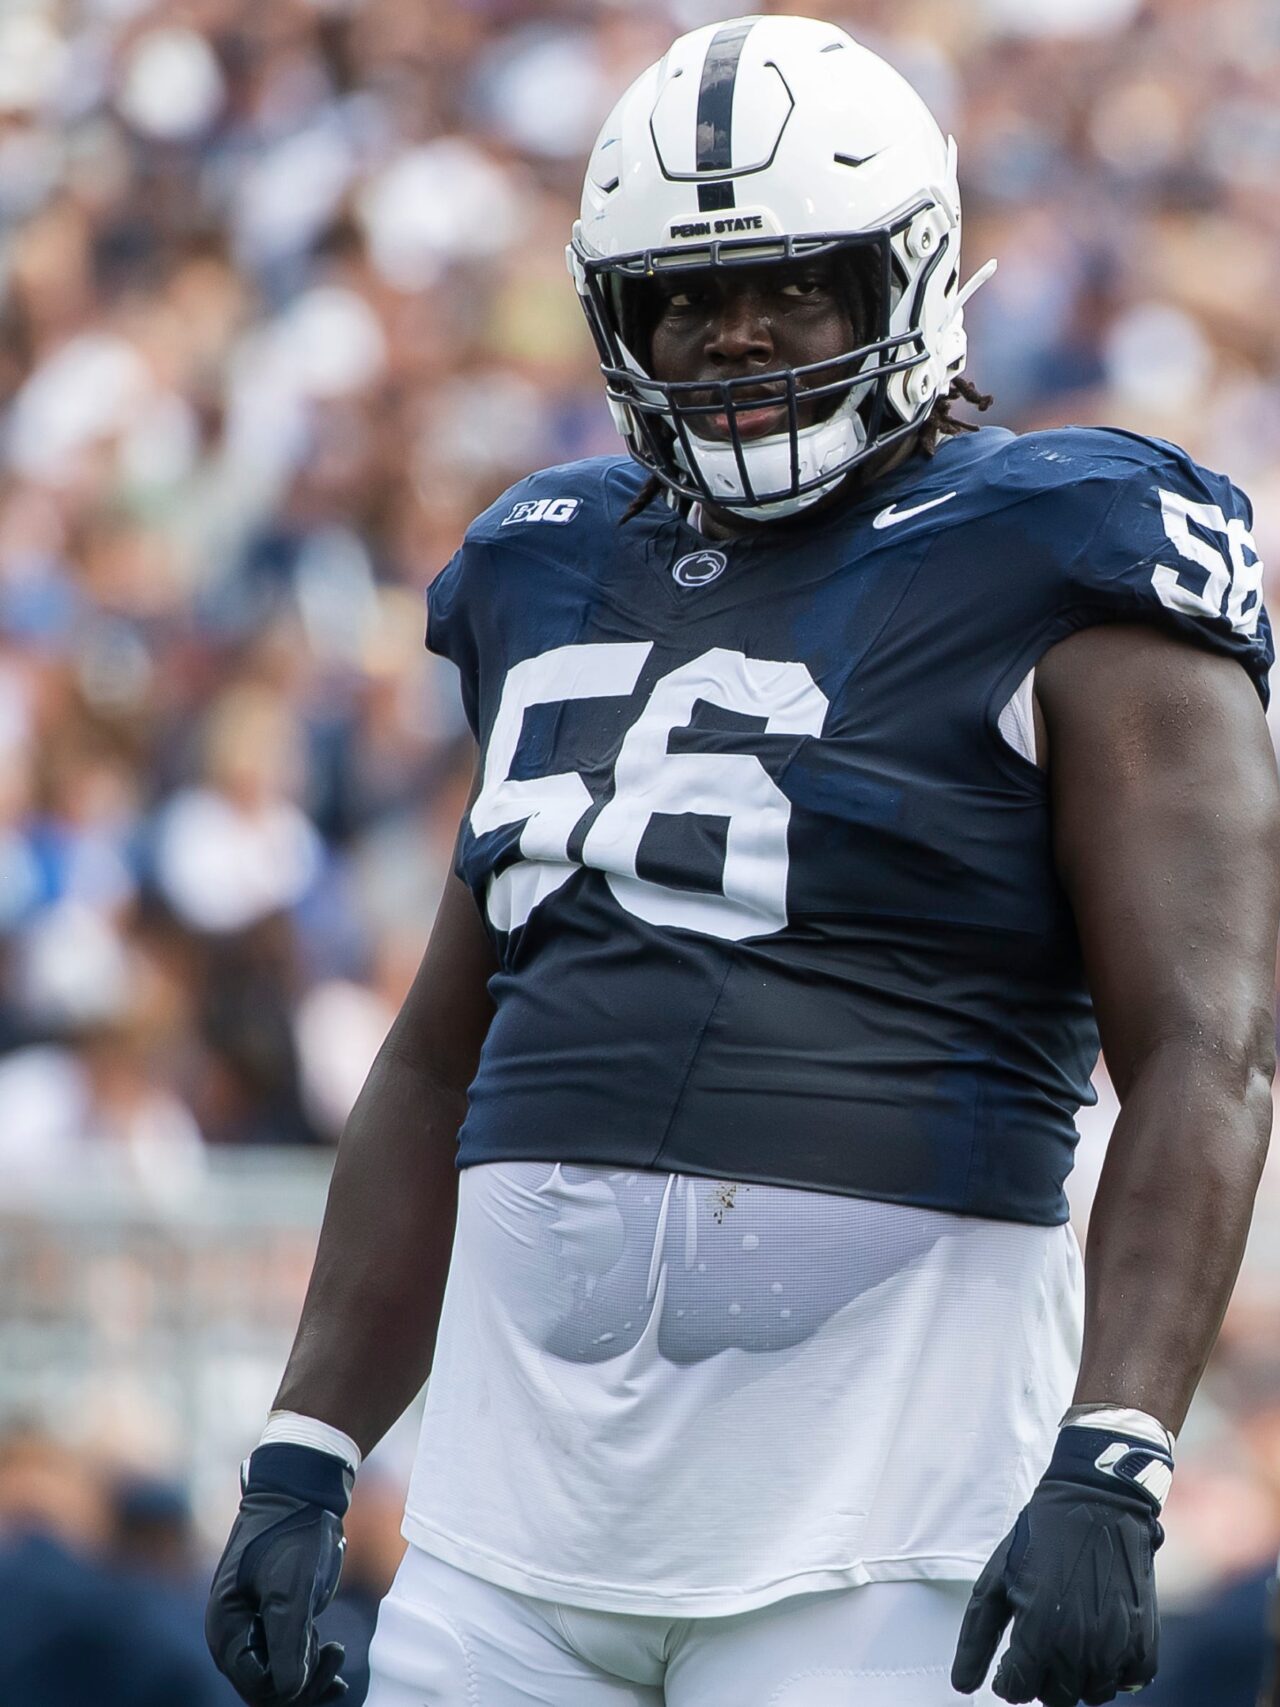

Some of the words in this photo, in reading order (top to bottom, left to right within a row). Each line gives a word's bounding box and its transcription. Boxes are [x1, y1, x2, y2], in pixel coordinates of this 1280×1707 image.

[670, 222, 711, 239] PENN
[714, 215, 763, 234] STATE
[1151, 488, 1264, 635] 56
[470, 641, 829, 941] 56
